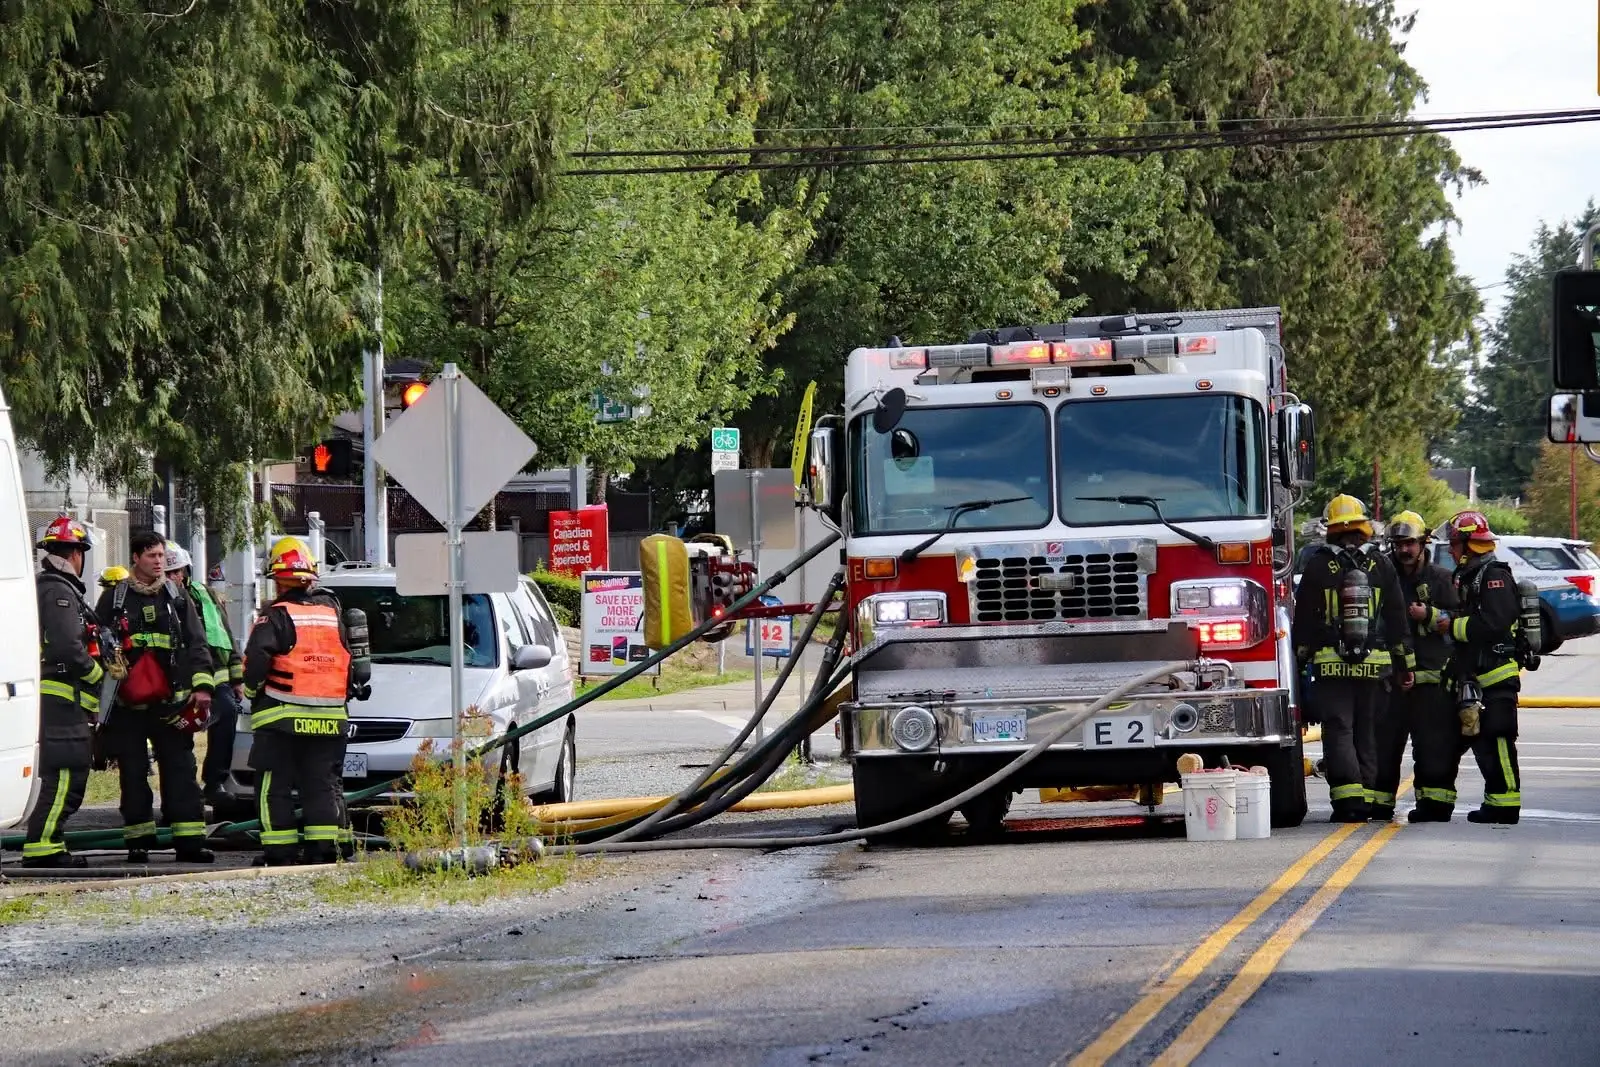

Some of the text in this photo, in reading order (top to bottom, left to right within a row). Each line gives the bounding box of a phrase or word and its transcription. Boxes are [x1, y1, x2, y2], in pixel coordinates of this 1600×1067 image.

[553, 527, 593, 539] Canadian
[553, 540, 590, 552] owned &
[552, 553, 592, 567] operated
[595, 594, 619, 605] SAVE
[606, 606, 635, 616] MORE
[601, 616, 615, 626] ON
[1320, 663, 1380, 678] BORTHISTLE
[294, 719, 339, 734] CORMACK
[1095, 720, 1145, 745] E 2
